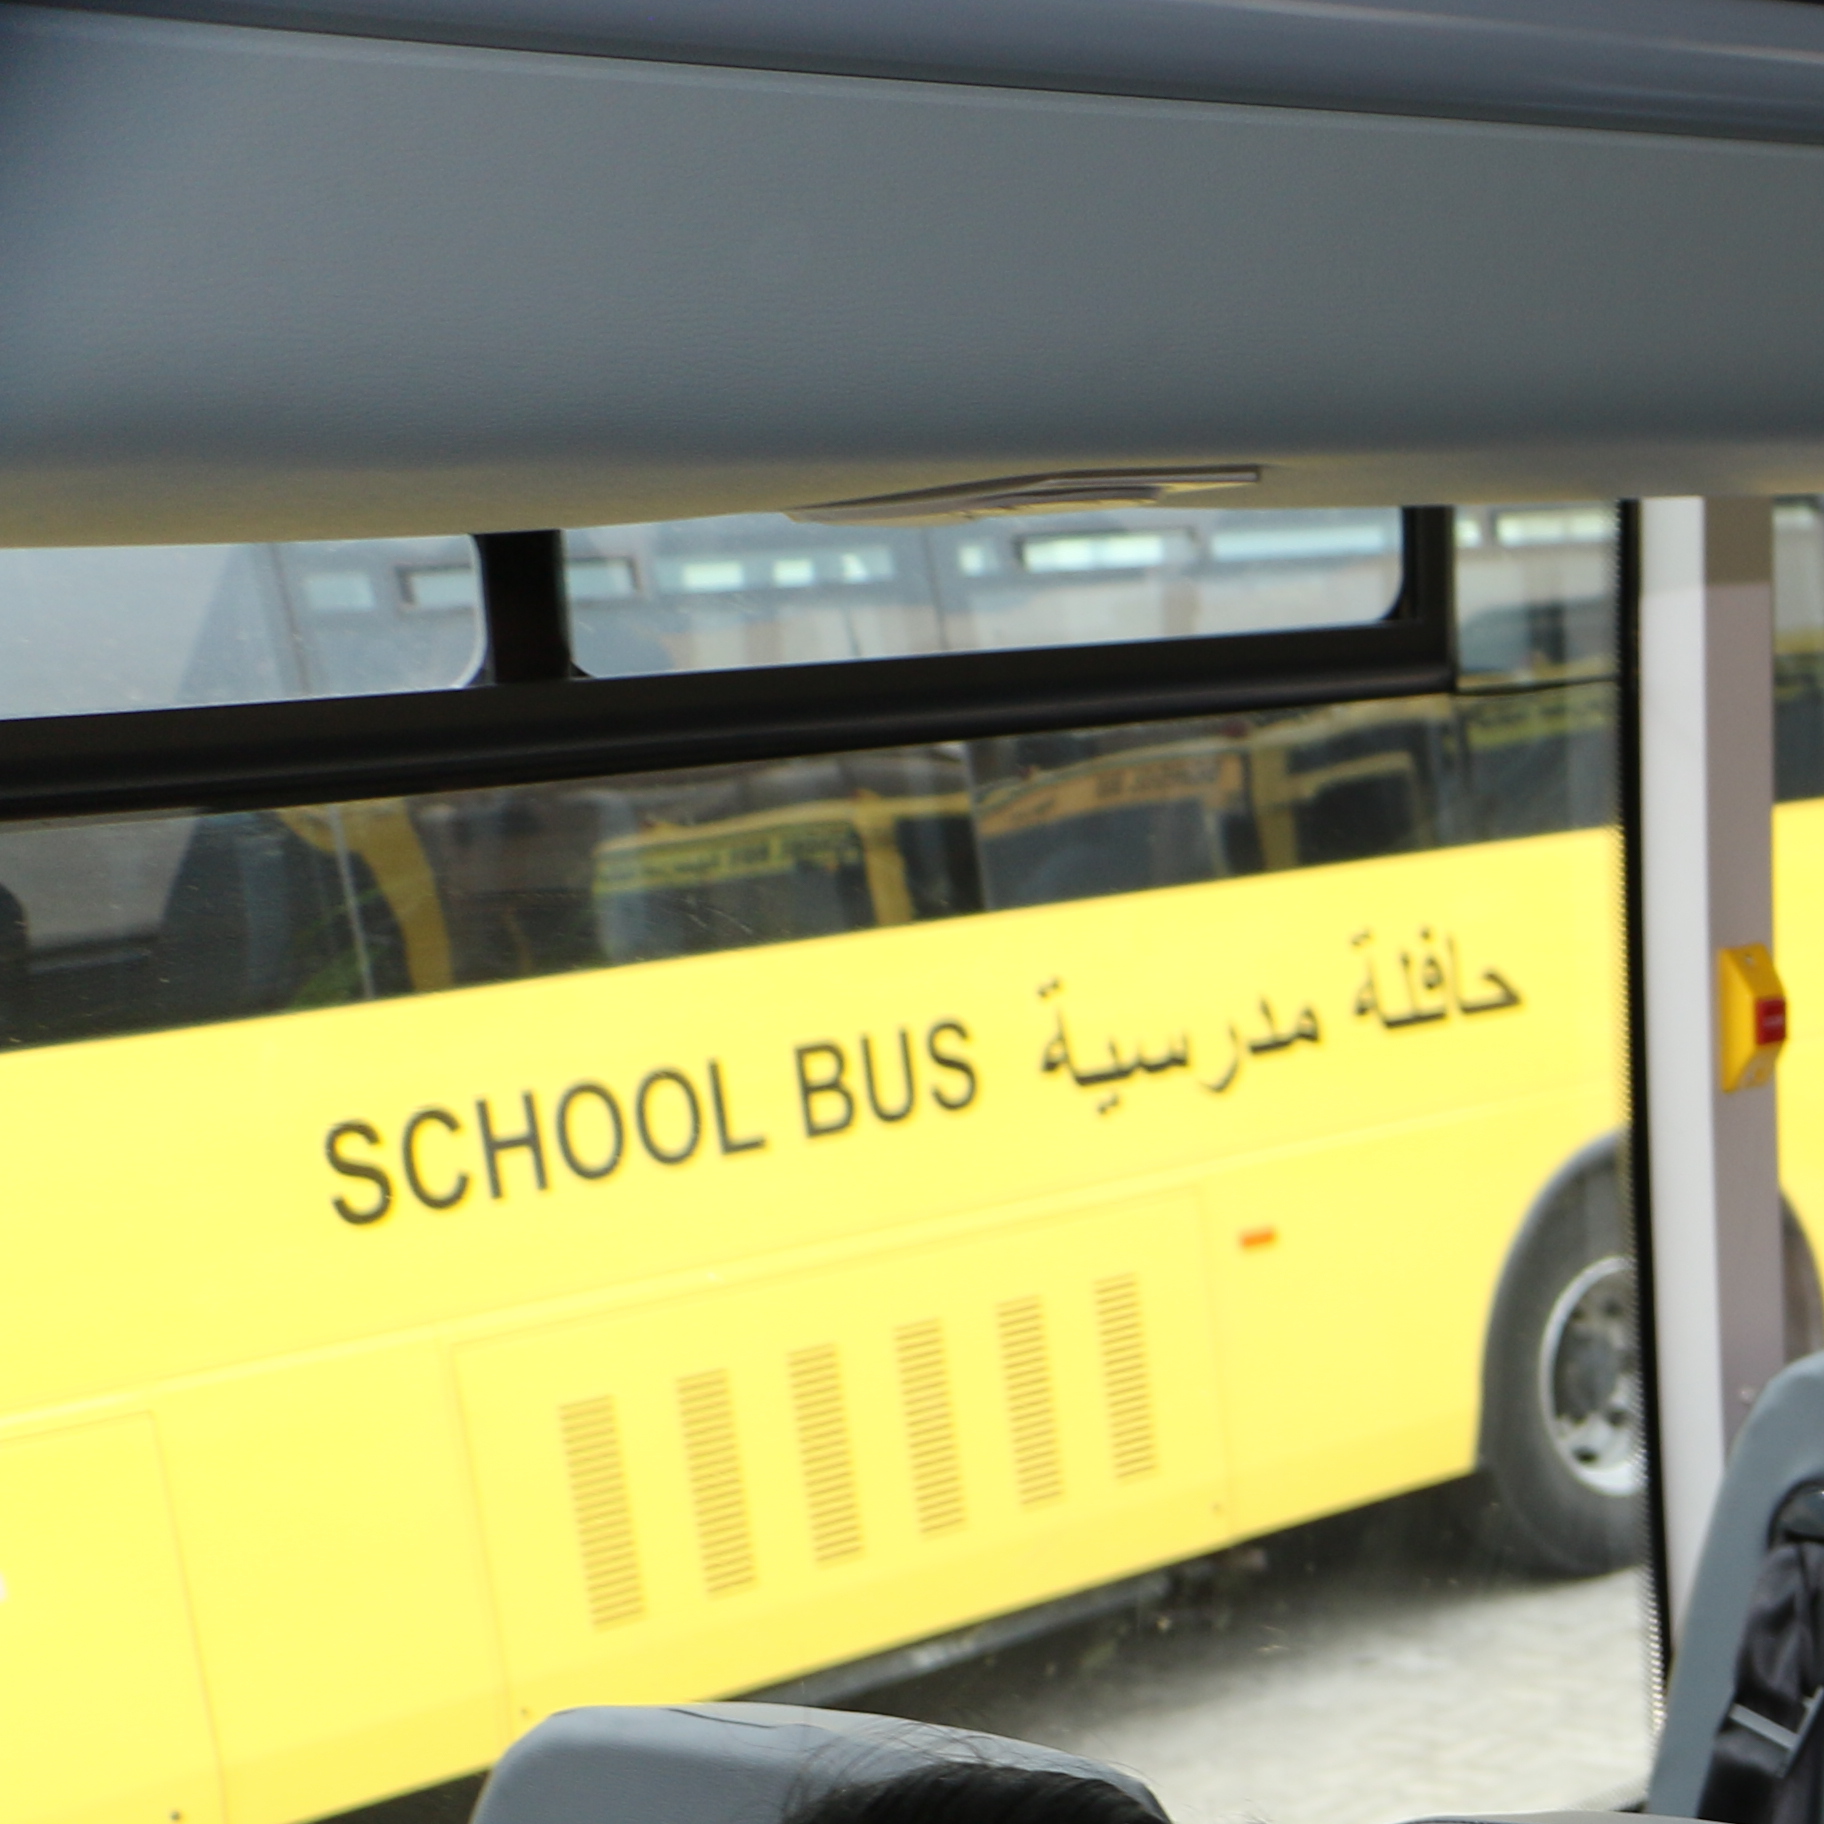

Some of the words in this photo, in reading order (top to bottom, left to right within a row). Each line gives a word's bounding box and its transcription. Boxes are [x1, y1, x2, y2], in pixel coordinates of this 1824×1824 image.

[1036, 978, 1321, 1115] مدرسية
[1351, 926, 1522, 1030] حافلة
[324, 1060, 767, 1226] SCHOOL
[794, 1018, 978, 1139] BUS
